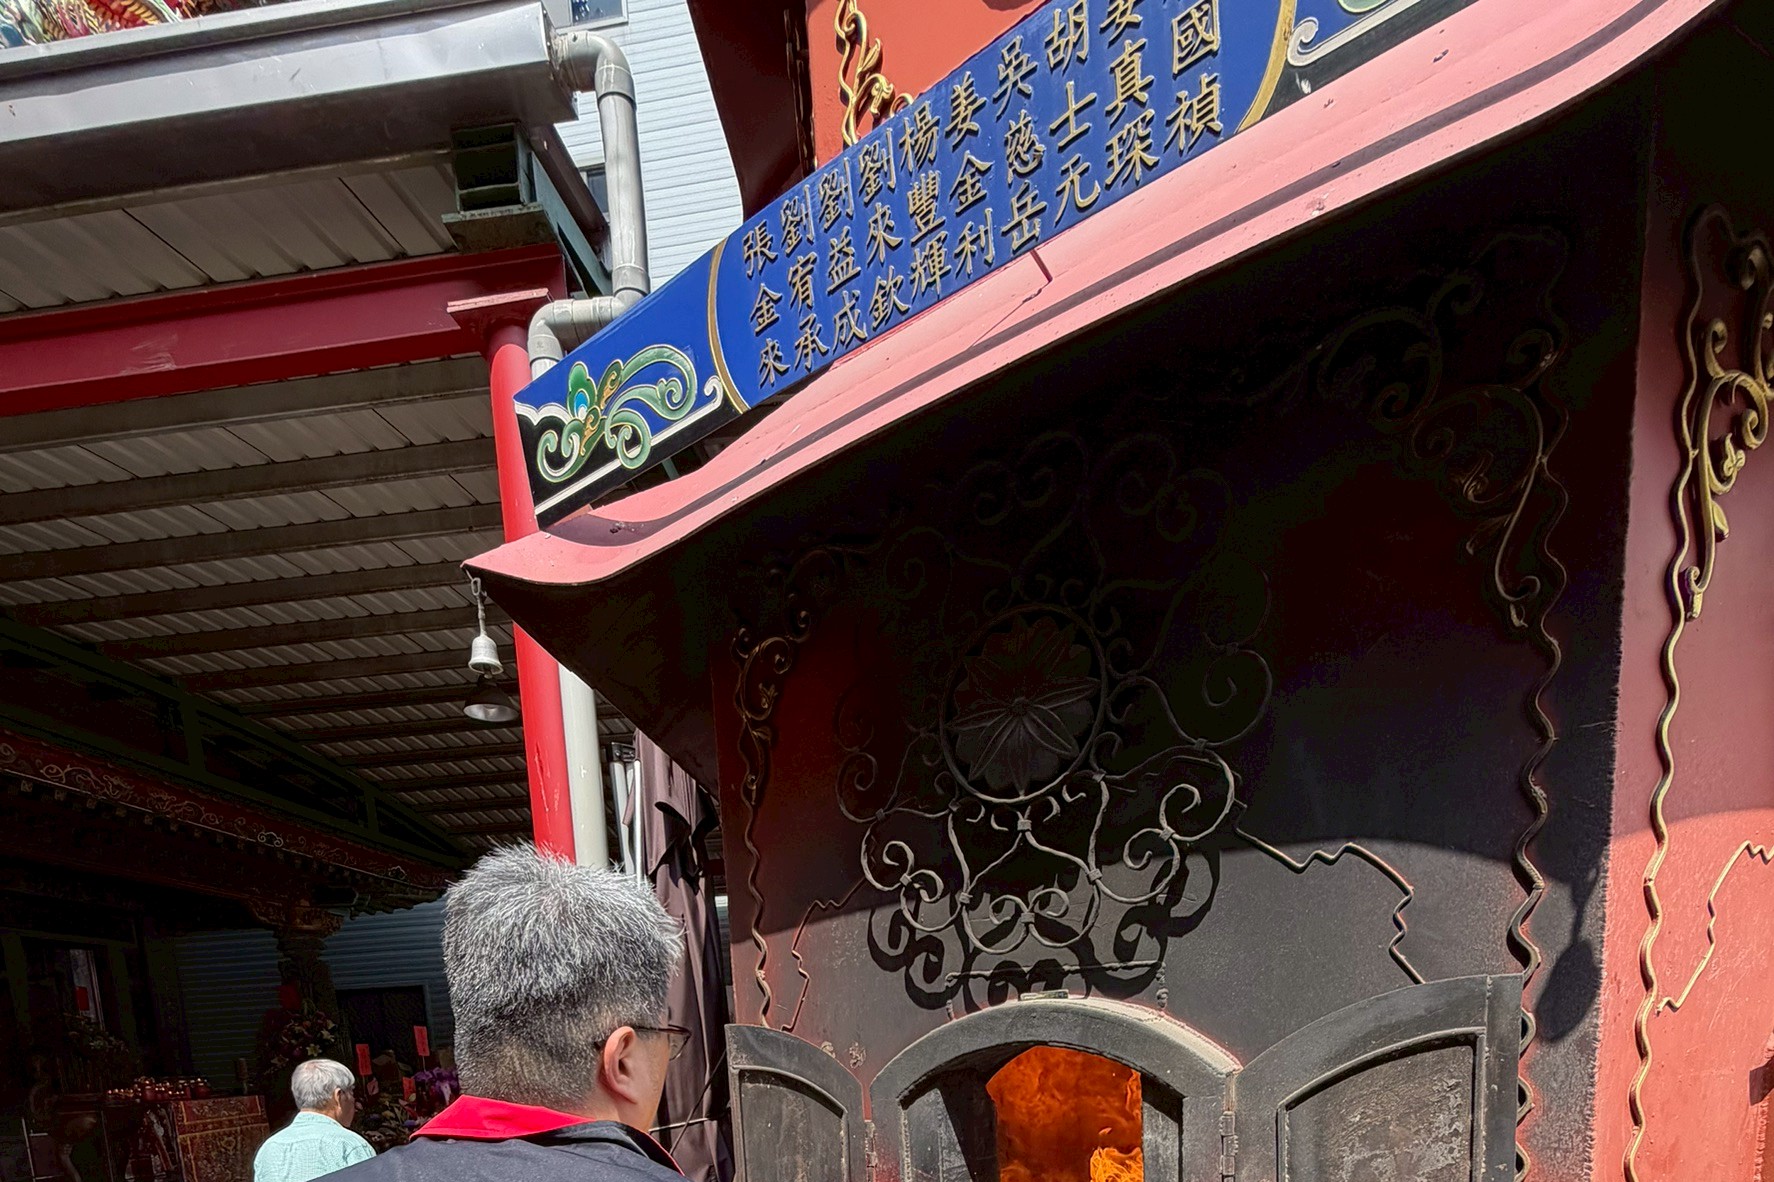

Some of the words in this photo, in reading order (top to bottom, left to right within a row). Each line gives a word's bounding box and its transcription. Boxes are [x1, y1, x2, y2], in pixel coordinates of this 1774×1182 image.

[898, 100, 952, 298] 楊豐輝
[944, 70, 996, 279] 姜金利
[992, 34, 1048, 254] 吳慈岳
[1044, 0, 1101, 226] 胡士元
[741, 219, 791, 387] 張金來
[818, 156, 868, 353] 劉益成
[857, 127, 911, 332] 劉來欽
